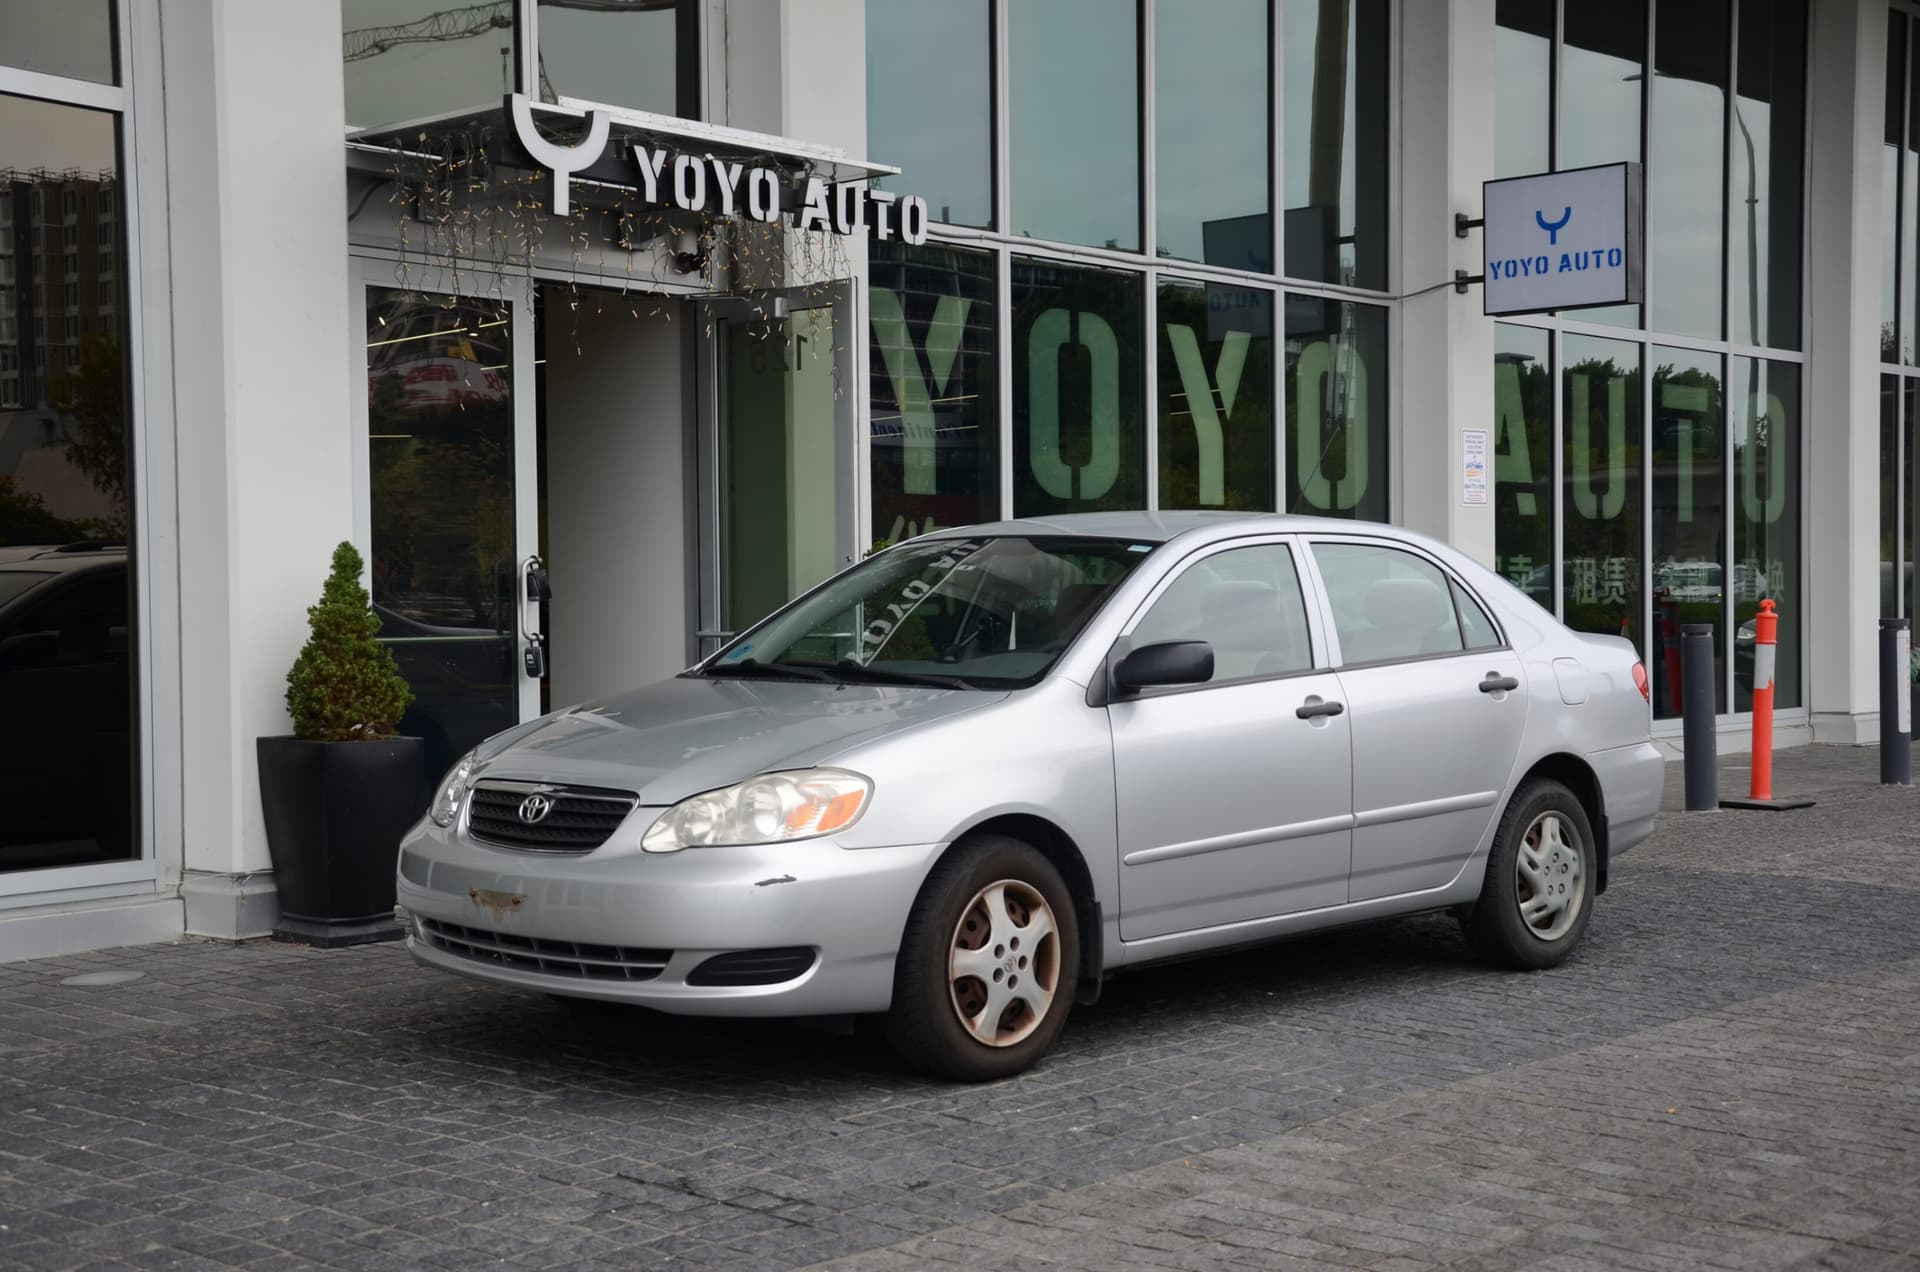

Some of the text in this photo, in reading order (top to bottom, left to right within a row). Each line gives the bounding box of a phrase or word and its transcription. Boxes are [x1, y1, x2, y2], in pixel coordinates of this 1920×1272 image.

[633, 144, 928, 246] YOYO AUTO
[1490, 248, 1622, 280] YOYO AUTO
[870, 287, 1369, 510] YOYO
